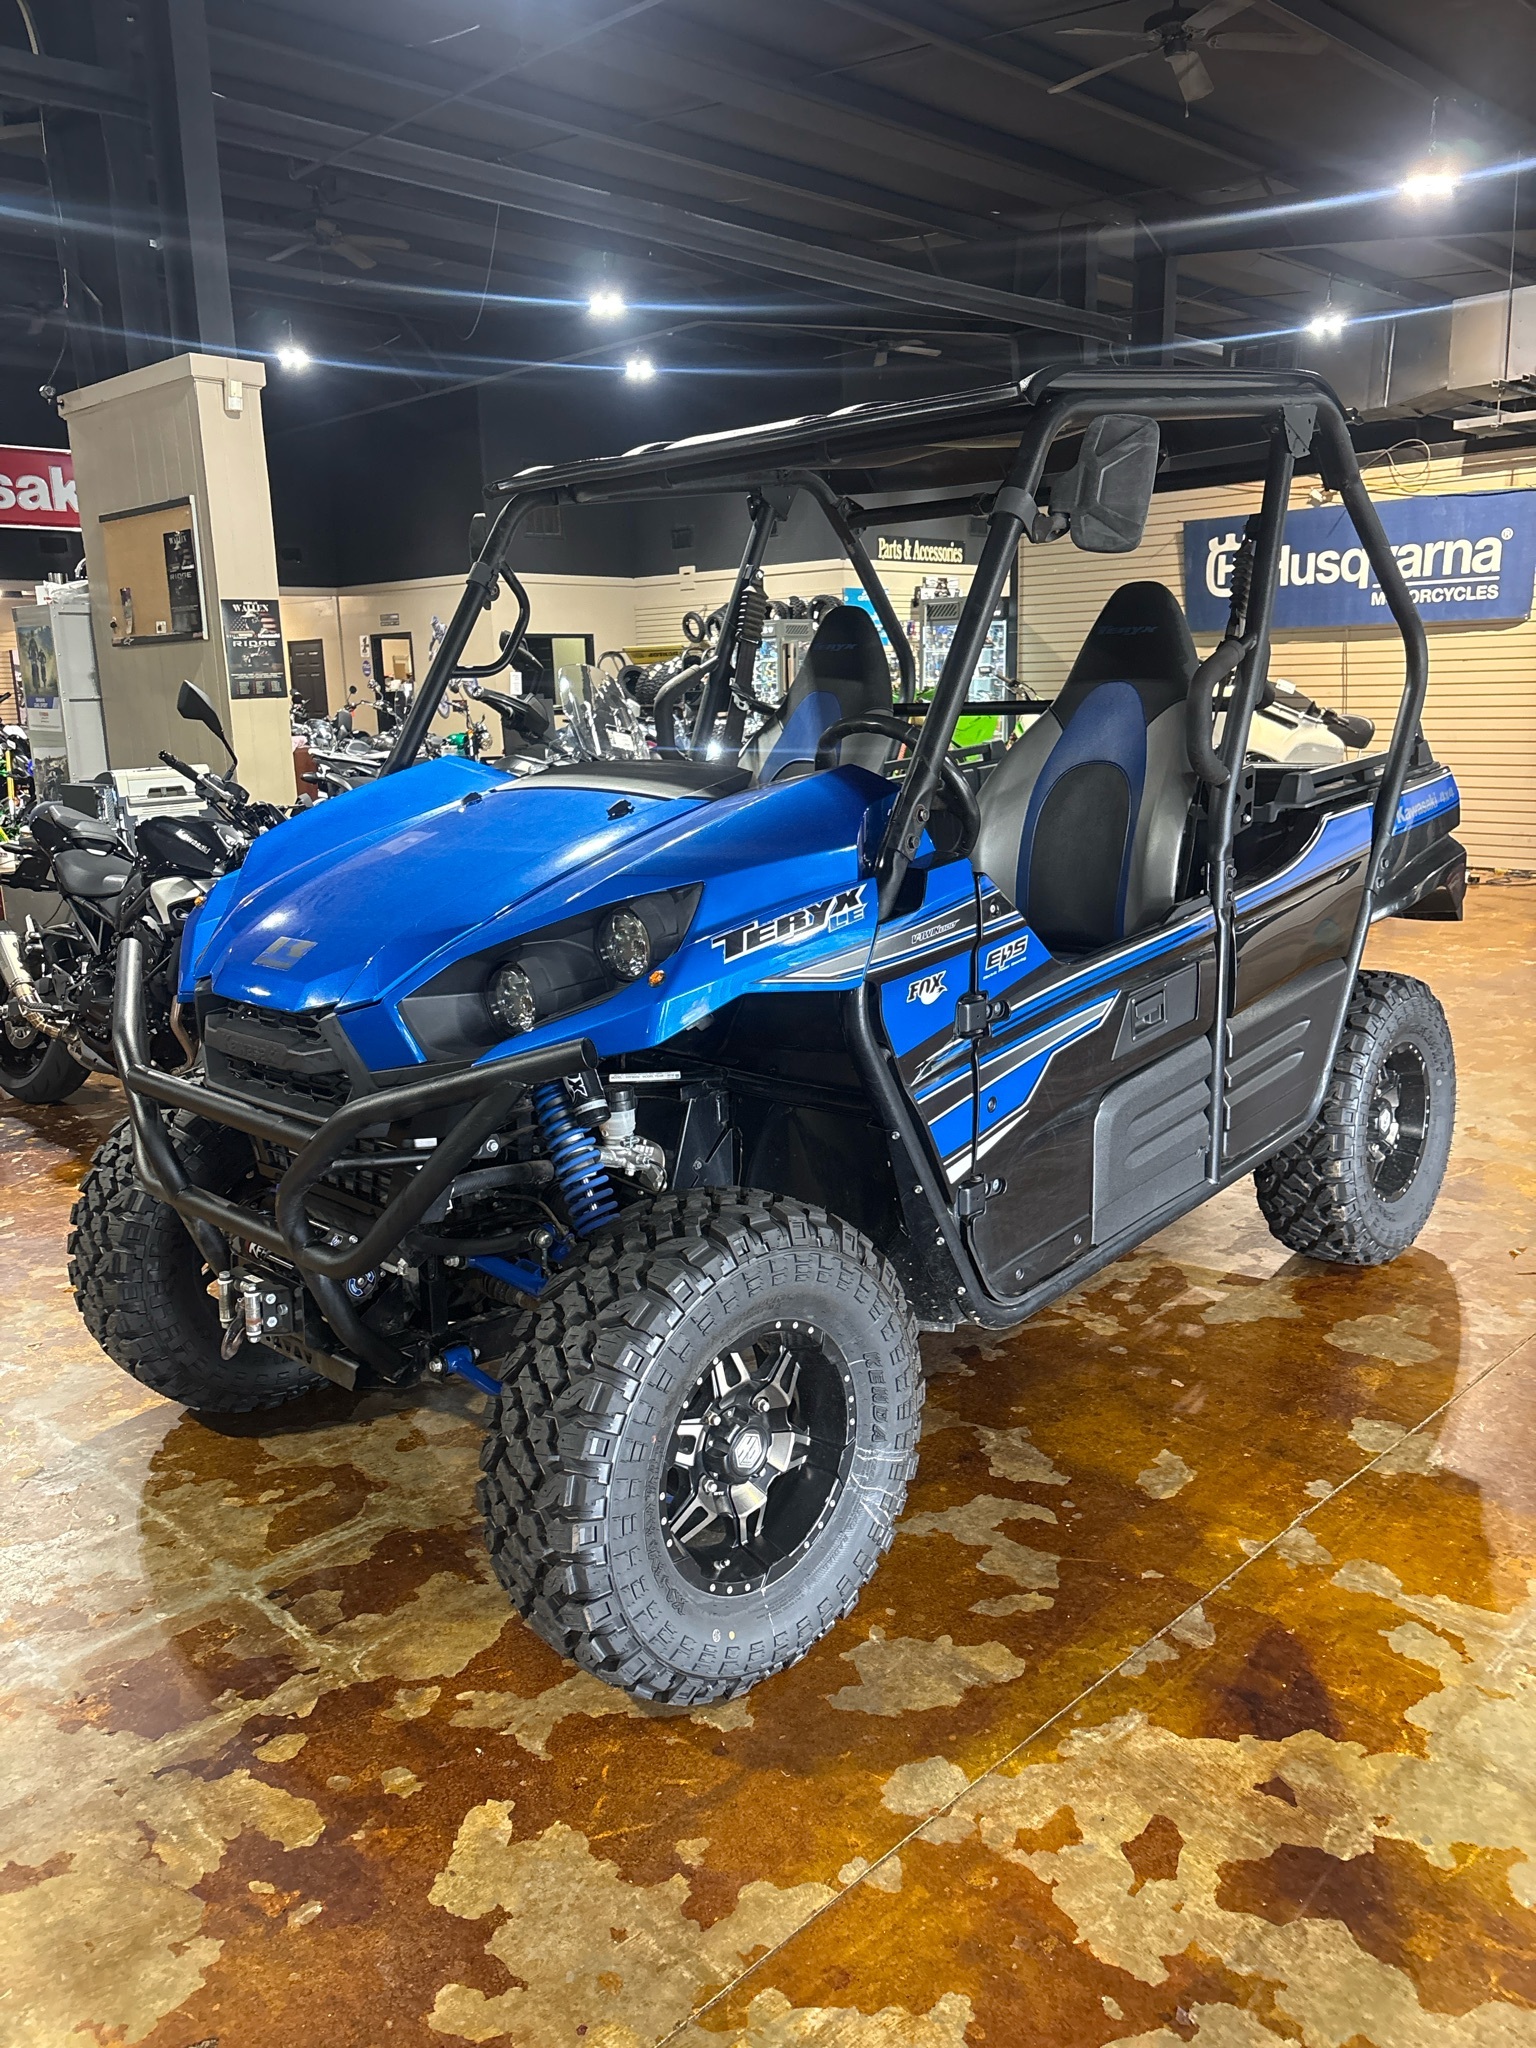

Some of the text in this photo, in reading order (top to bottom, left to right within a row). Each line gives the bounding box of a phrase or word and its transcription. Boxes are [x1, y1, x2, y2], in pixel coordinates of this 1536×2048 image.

[878, 537, 963, 563] Parts & Accessories
[1279, 536, 1503, 590] Husqarna
[1370, 584, 1499, 607] MORCYCLES
[233, 640, 277, 648] RIDGE
[1396, 786, 1455, 824] Kawasaki 4x4
[175, 828, 212, 856] Kawasaki
[711, 883, 867, 965] TERYX
[828, 902, 868, 933] LE
[984, 934, 1029, 972] EPS
[906, 969, 949, 1004] FOX
[862, 1351, 889, 1443] KENDA
